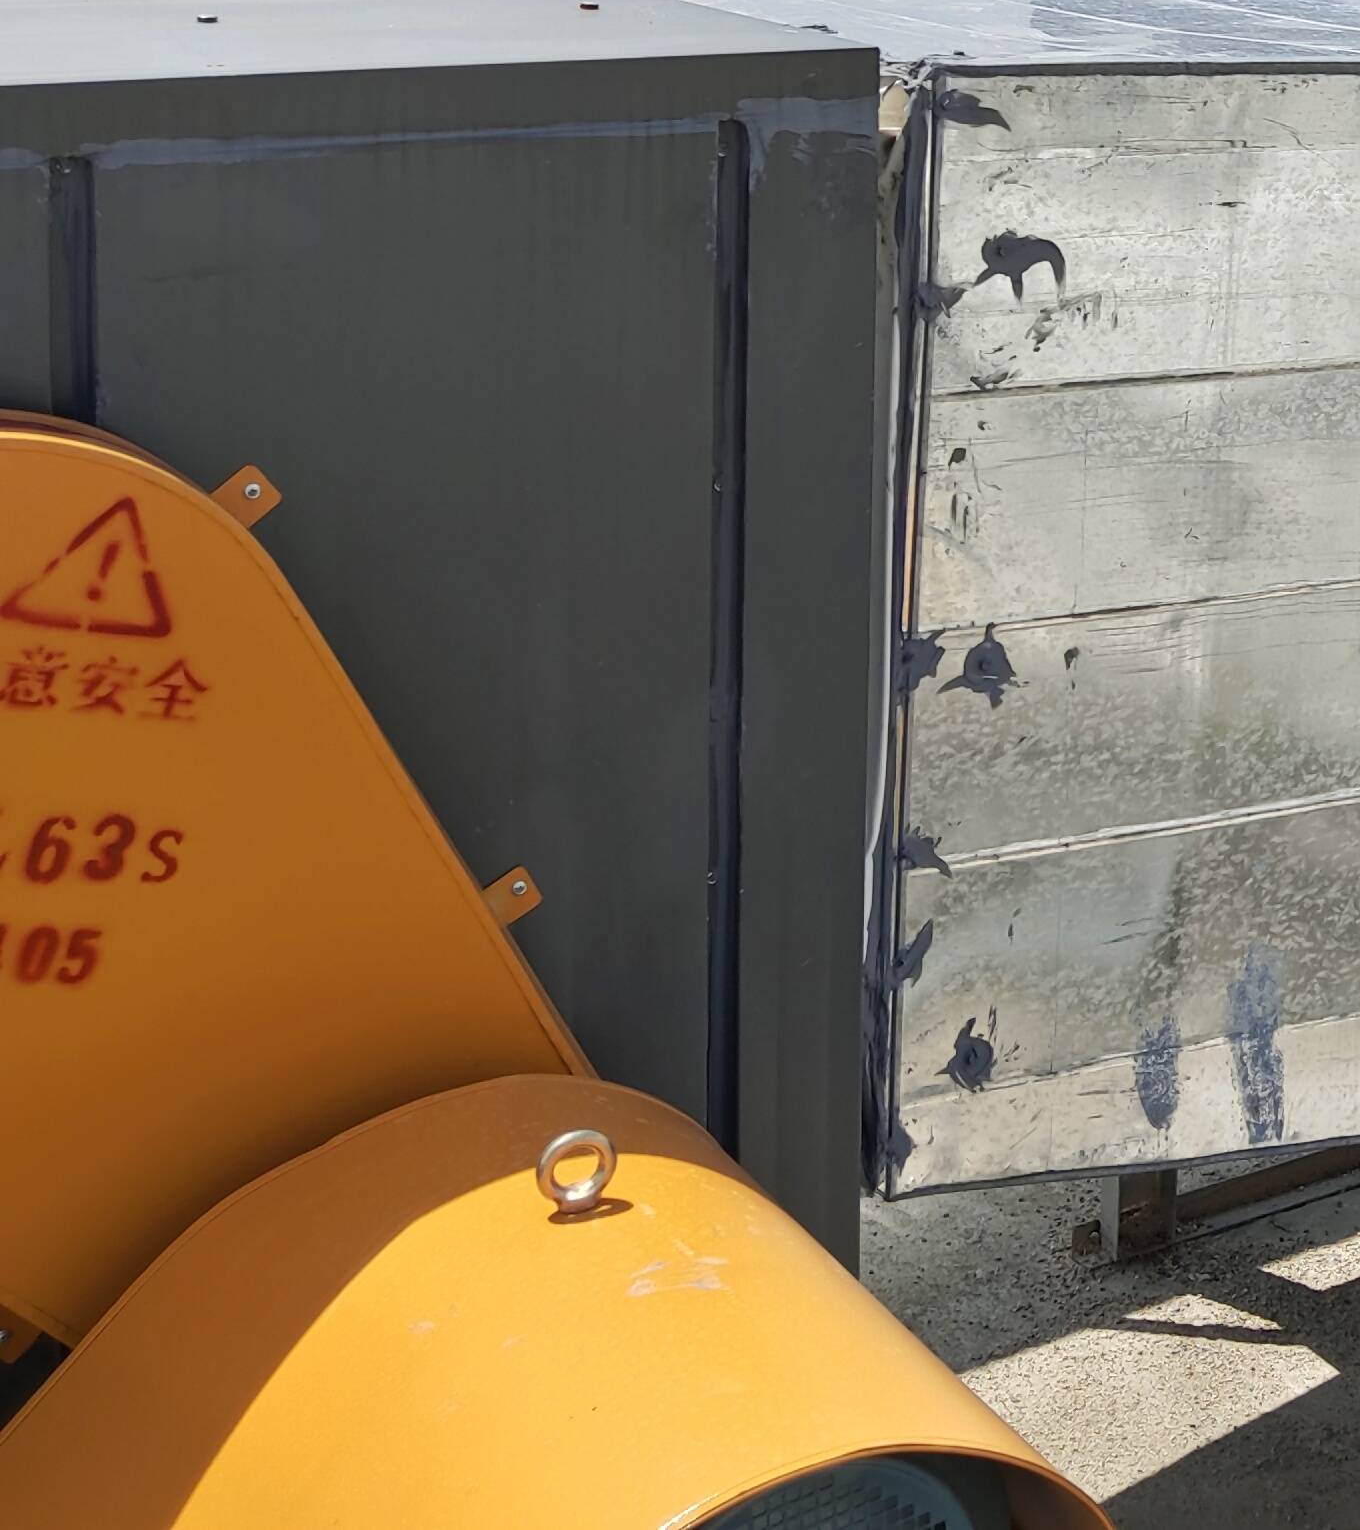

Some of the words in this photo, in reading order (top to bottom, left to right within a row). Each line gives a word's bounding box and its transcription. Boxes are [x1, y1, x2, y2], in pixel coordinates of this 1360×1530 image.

[0, 645, 208, 721] 意安全
[0, 813, 184, 884] 63S
[0, 924, 103, 985] 05
